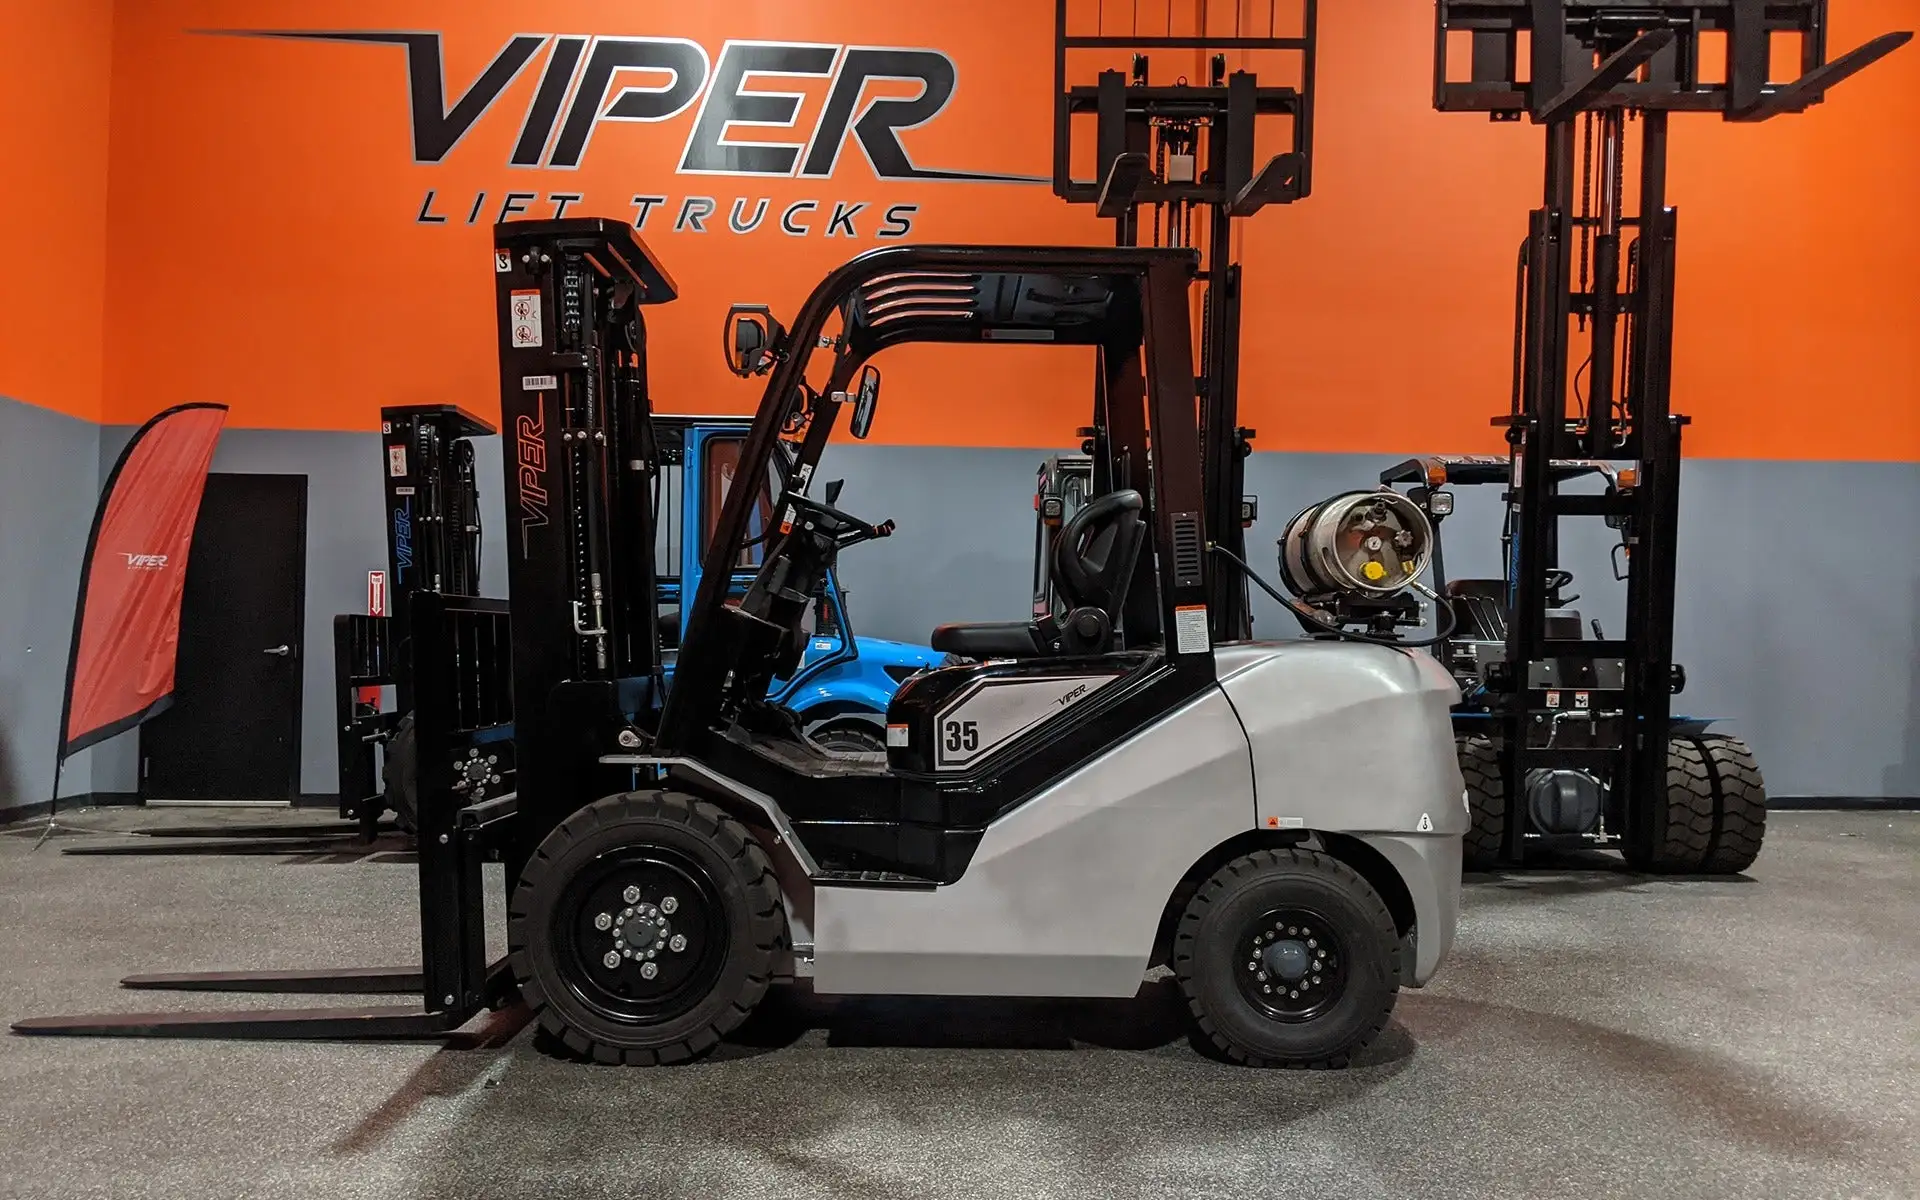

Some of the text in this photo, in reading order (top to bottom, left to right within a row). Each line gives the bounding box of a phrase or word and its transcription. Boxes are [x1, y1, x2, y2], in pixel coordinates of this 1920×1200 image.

[184, 29, 1053, 184] VIPER
[416, 188, 920, 238] LIFT TRUCKS
[517, 392, 549, 559] VIPER
[116, 552, 168, 566] VIPER
[394, 496, 412, 584] VIPER
[1049, 683, 1091, 706] VIPER
[945, 720, 980, 752] 35
